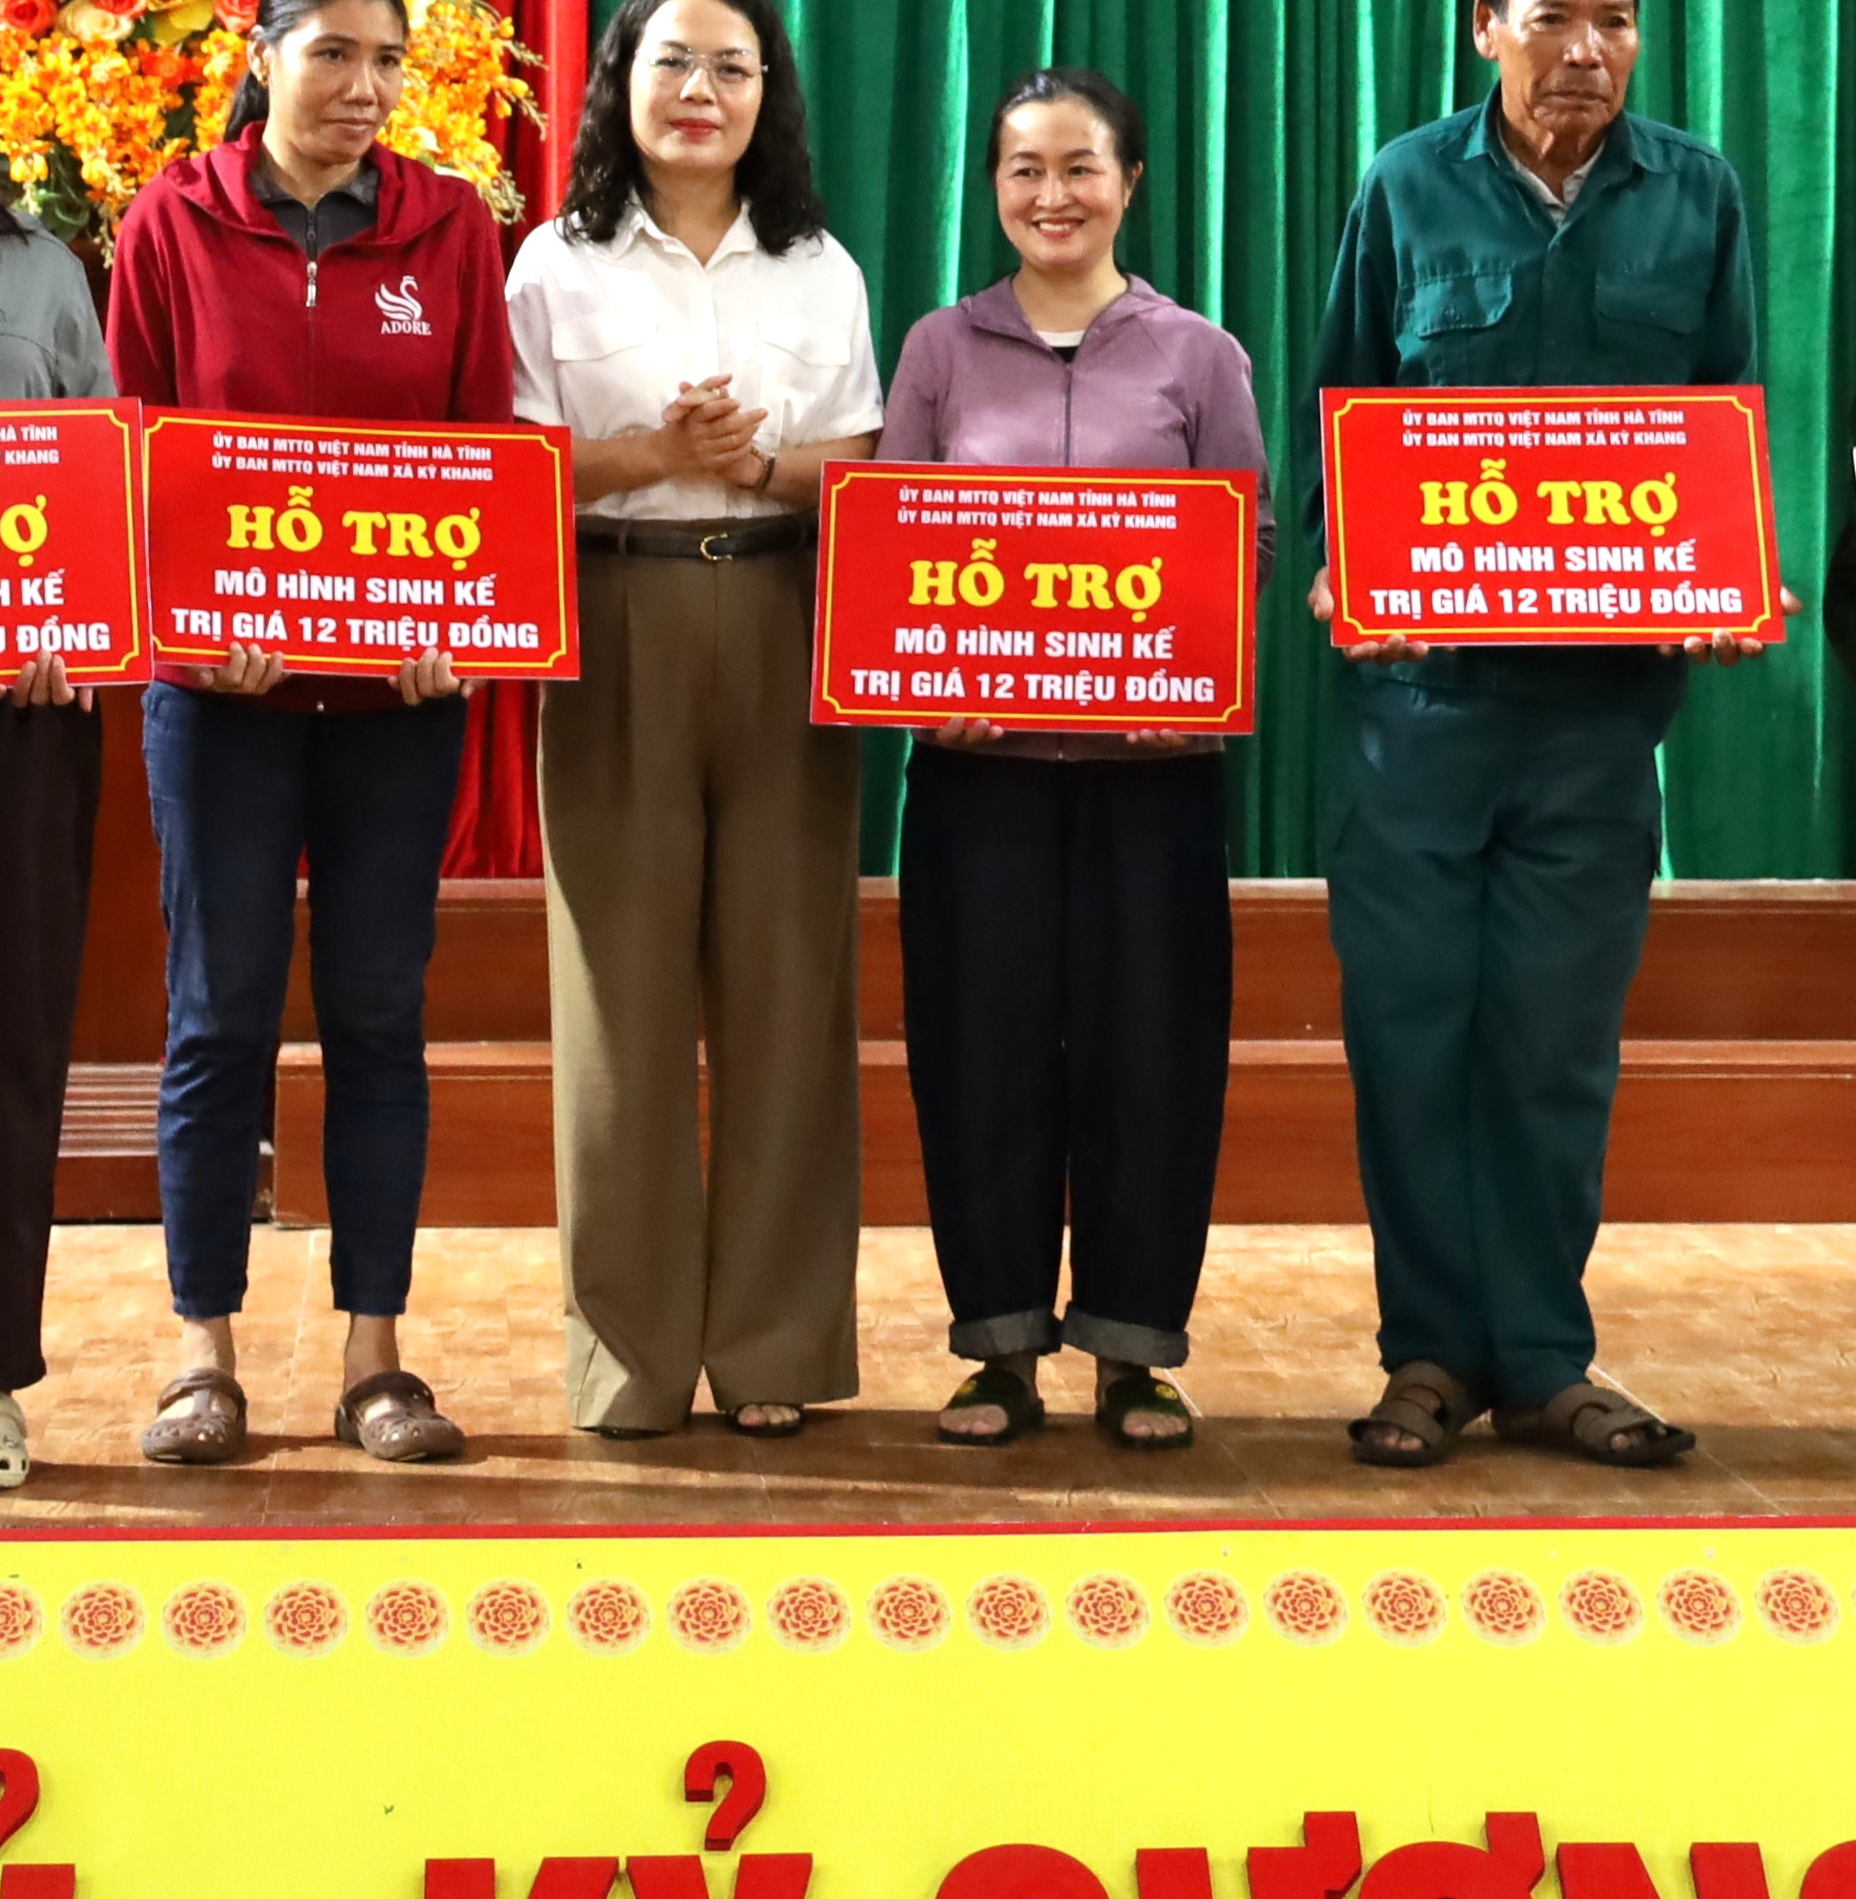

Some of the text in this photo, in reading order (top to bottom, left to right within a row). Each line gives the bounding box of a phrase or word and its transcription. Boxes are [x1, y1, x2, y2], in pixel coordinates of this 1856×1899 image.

[381, 321, 431, 335] ADORE
[21, 425, 57, 441] TĨNH
[1403, 408, 1684, 427] ỦY BAN MTTQ VIỆT NAM TỈNH HÀ TĨNH
[1420, 459, 1678, 537] HỖ TRỢ
[227, 486, 480, 570] HỖ TRỢ
[898, 507, 1176, 528] ỦY BAN MTTQ VIỆT NAM XÃ KỲ KHANG
[1411, 539, 1696, 572] MÔ HÌNH SINH KẾ
[22, 569, 64, 605] KẾ
[215, 567, 496, 605] MÔ HÌNH SINH KẾ
[909, 539, 1162, 622] HỖ TRỢ
[1370, 580, 1742, 619] TRỊ GIÁ 12 TRIỆU ĐỒNG
[16, 615, 110, 653] ĐỒNG
[171, 608, 538, 651] TRỊ GIÁ 12 TRIỆU ĐỒNG
[895, 624, 1175, 658] MÔ HÌNH SINH KẾ
[851, 667, 1214, 705] TRỊ GIÁ 12 TRIỆU ĐỒNG
